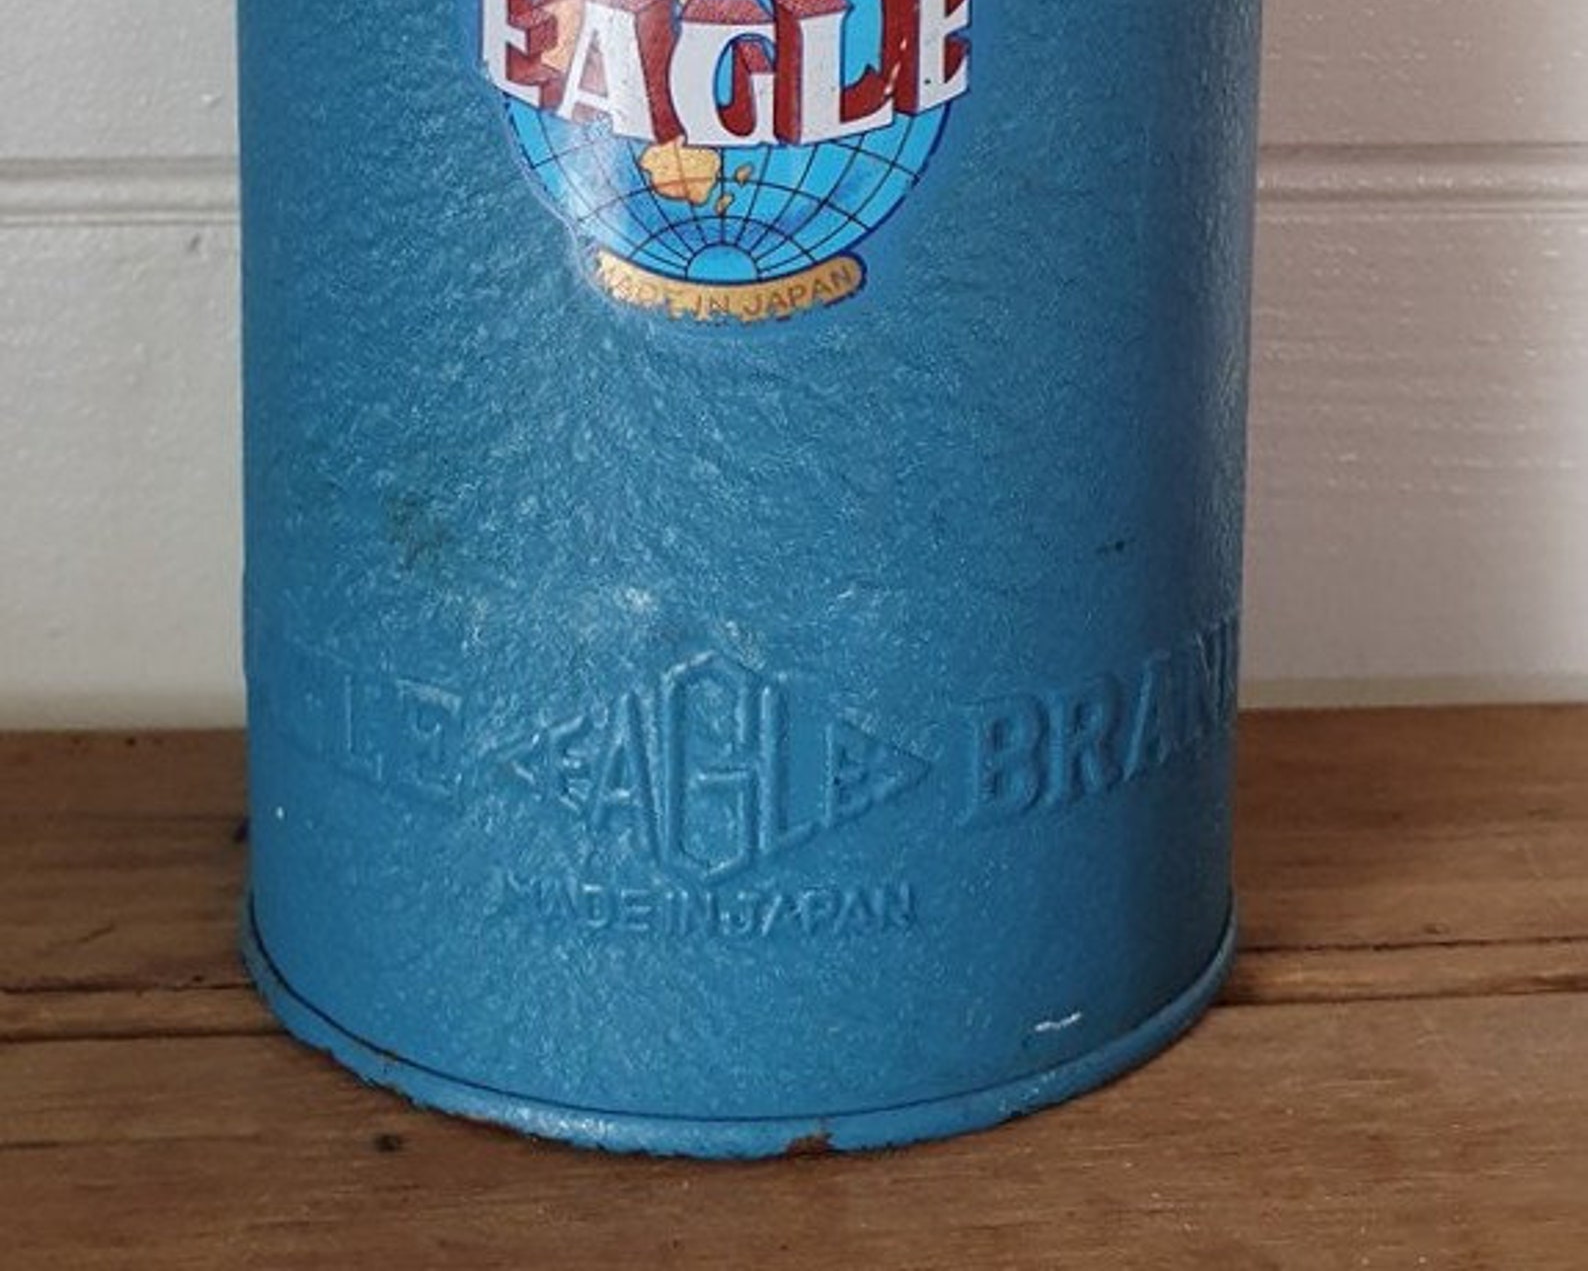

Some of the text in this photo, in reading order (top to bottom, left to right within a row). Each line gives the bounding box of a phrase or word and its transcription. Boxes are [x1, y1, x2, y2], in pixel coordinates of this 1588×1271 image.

[693, 295, 730, 314] IN
[742, 263, 852, 316] JAPAN
[661, 888, 714, 934] IN
[718, 878, 916, 937] JAPAN
